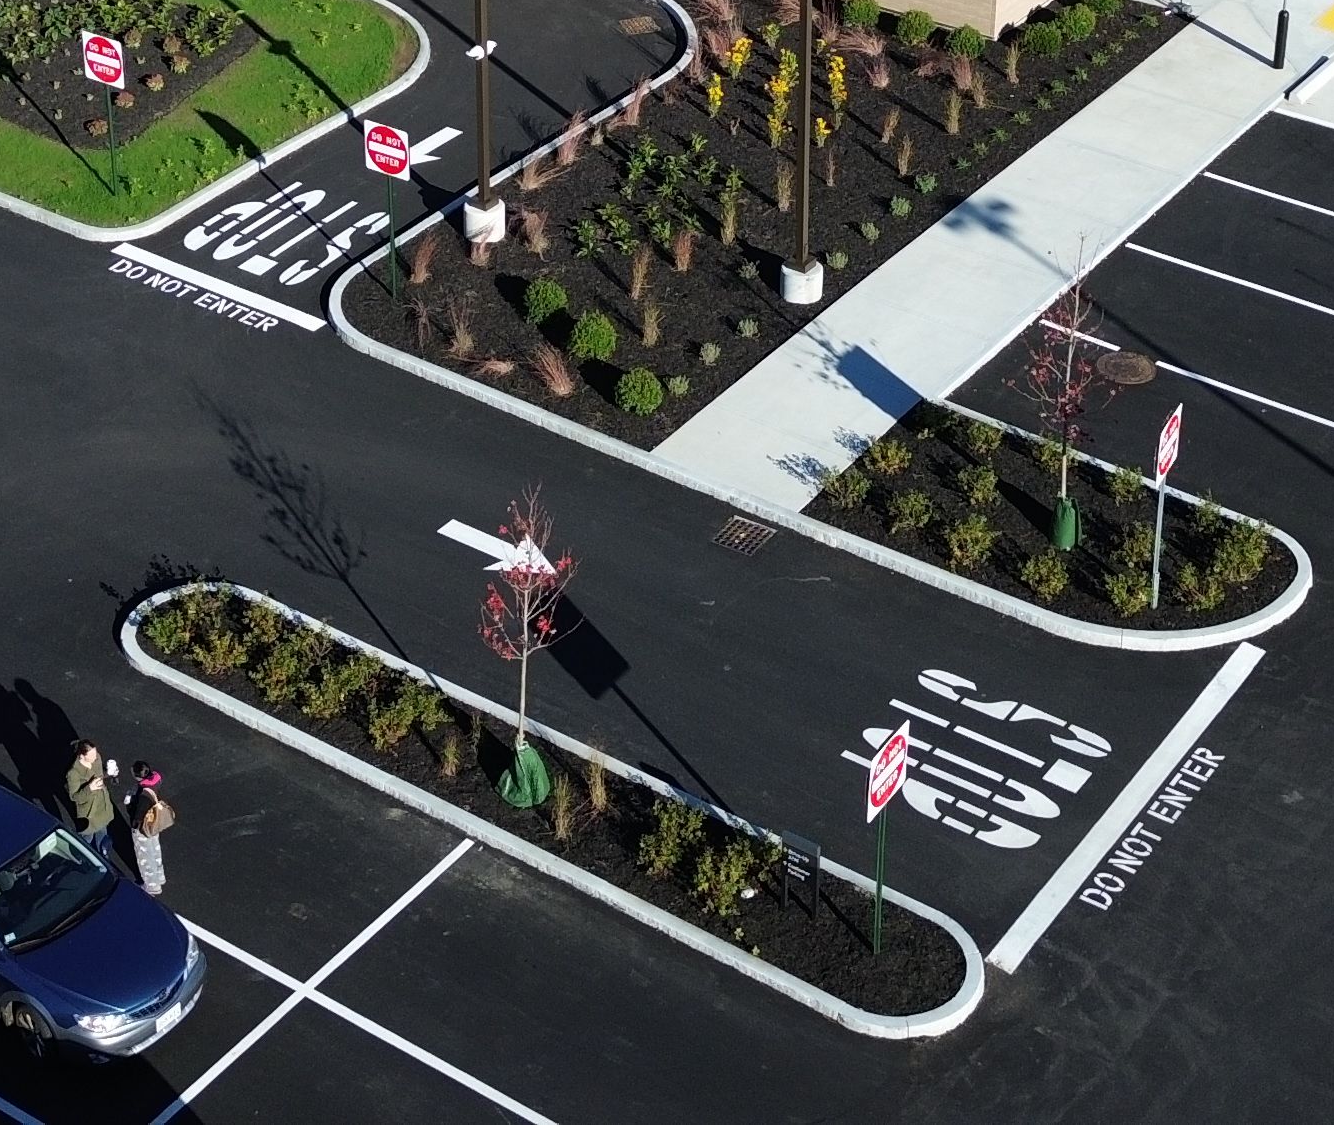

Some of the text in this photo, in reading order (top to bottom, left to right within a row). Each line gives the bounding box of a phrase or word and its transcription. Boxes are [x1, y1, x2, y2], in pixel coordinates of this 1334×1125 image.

[88, 41, 116, 57] DO NOT
[93, 63, 116, 77] ENTER
[371, 131, 402, 148] DO NOT
[375, 153, 400, 168] ENTER
[183, 181, 391, 286] STOP
[108, 258, 280, 333] DO NOT ENTER
[840, 669, 1113, 849] STOP
[875, 738, 903, 776] DO NOT
[876, 769, 899, 802] ENTER
[1078, 746, 1227, 911] DO NOT ENTER
